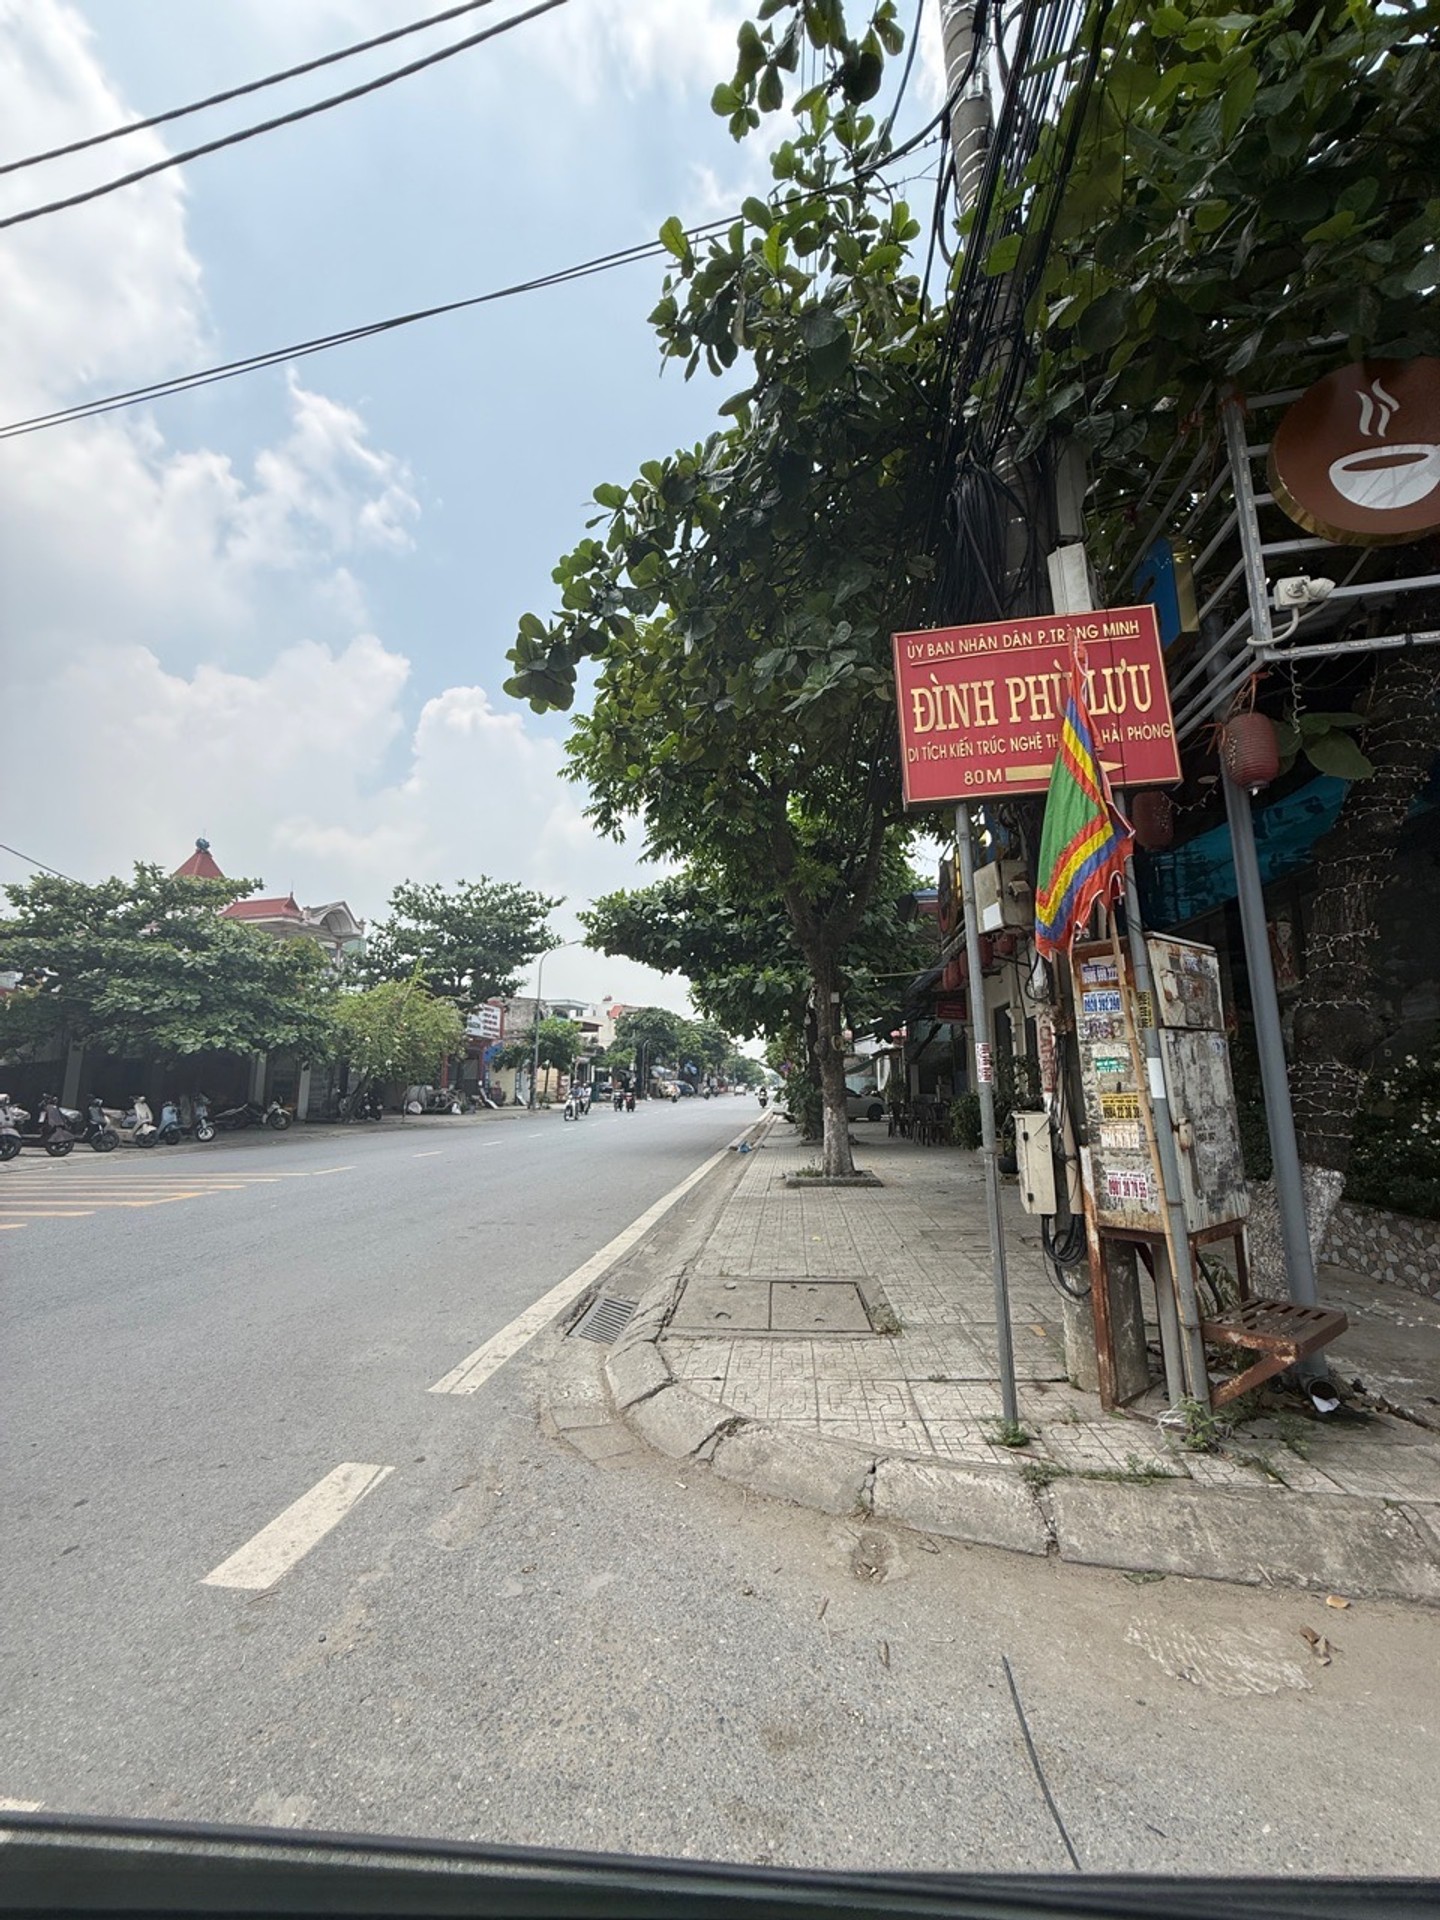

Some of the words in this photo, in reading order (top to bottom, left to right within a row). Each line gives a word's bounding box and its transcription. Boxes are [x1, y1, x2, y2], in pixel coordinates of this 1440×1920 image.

[927, 639, 955, 657] BAN
[959, 633, 998, 653] NHÂN
[1003, 629, 1032, 649] DÂN
[1103, 619, 1140, 638] MINH
[911, 672, 999, 734] ĐÌNH
[1005, 659, 1073, 724] PHÙ
[1086, 657, 1153, 717] LƯU
[908, 748, 918, 762] DI
[922, 741, 947, 761] TÍCH
[949, 737, 974, 758] KIẾN
[977, 735, 1006, 755] TRÚC
[1010, 731, 1043, 755] NGHỆ
[1128, 720, 1172, 741] PHÒNG
